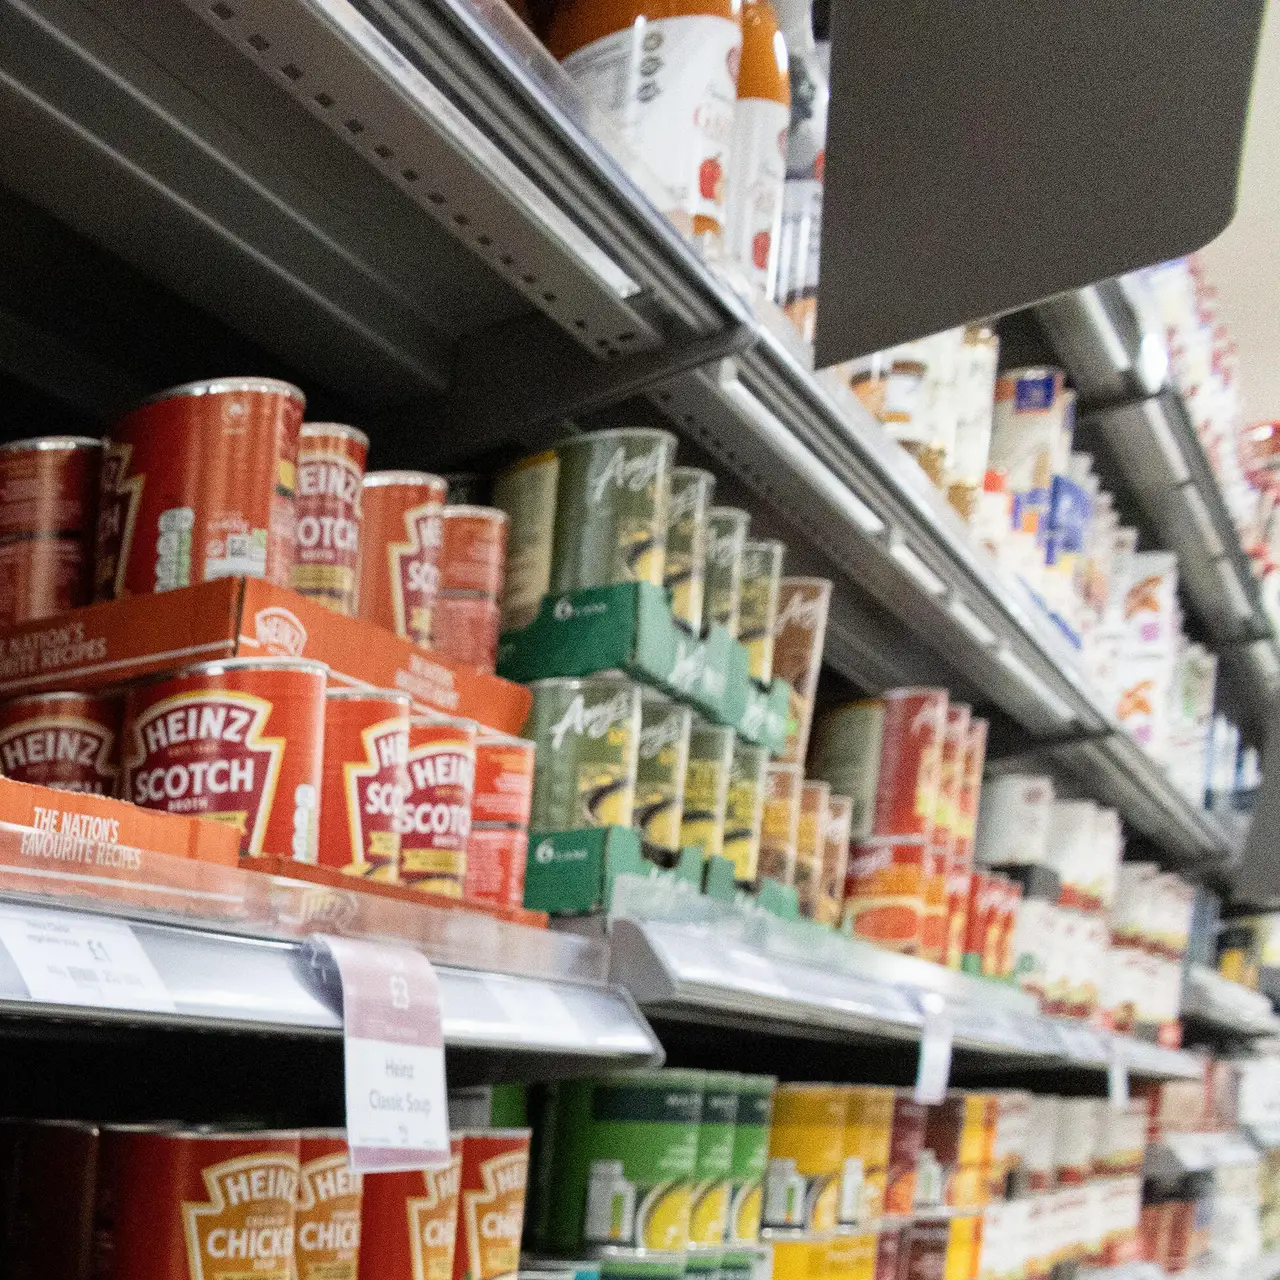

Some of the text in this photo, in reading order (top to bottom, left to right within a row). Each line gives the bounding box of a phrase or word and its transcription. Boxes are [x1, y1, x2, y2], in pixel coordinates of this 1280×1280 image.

[146, 707, 250, 752] HEINZ
[2, 730, 100, 770] HEINZ
[135, 758, 254, 804] SCOTCH
[32, 806, 120, 844] THE NATION'S
[20, 831, 140, 871] FAVOURITE RECIPES
[385, 1060, 415, 1079] Heinz
